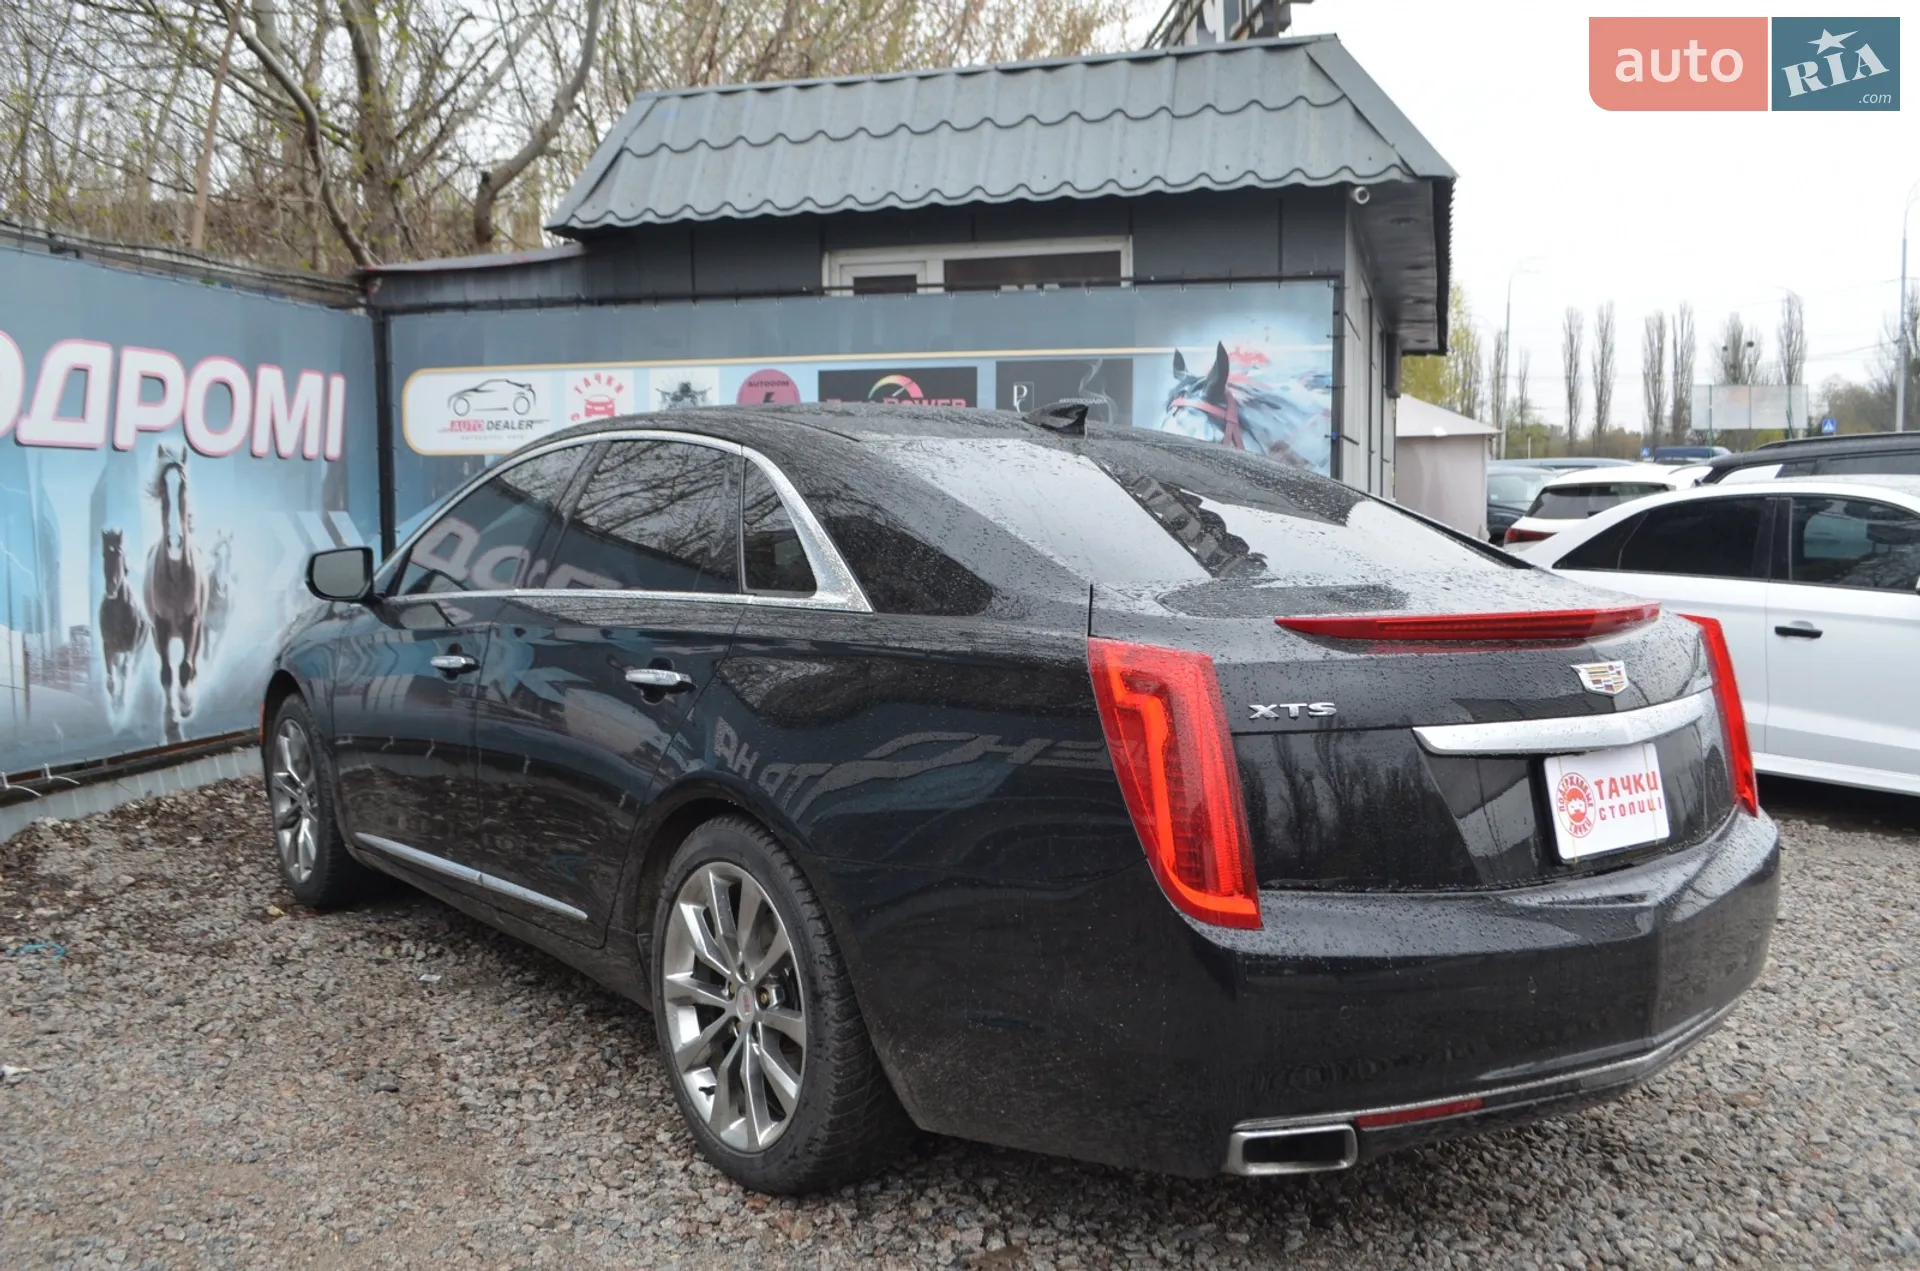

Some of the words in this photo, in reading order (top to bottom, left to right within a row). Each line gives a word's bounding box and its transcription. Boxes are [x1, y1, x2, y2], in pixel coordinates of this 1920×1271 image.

[486, 419, 534, 431] DEALER
[1248, 702, 1337, 719] XTS
[1594, 770, 1659, 801] ТАЧКИ
